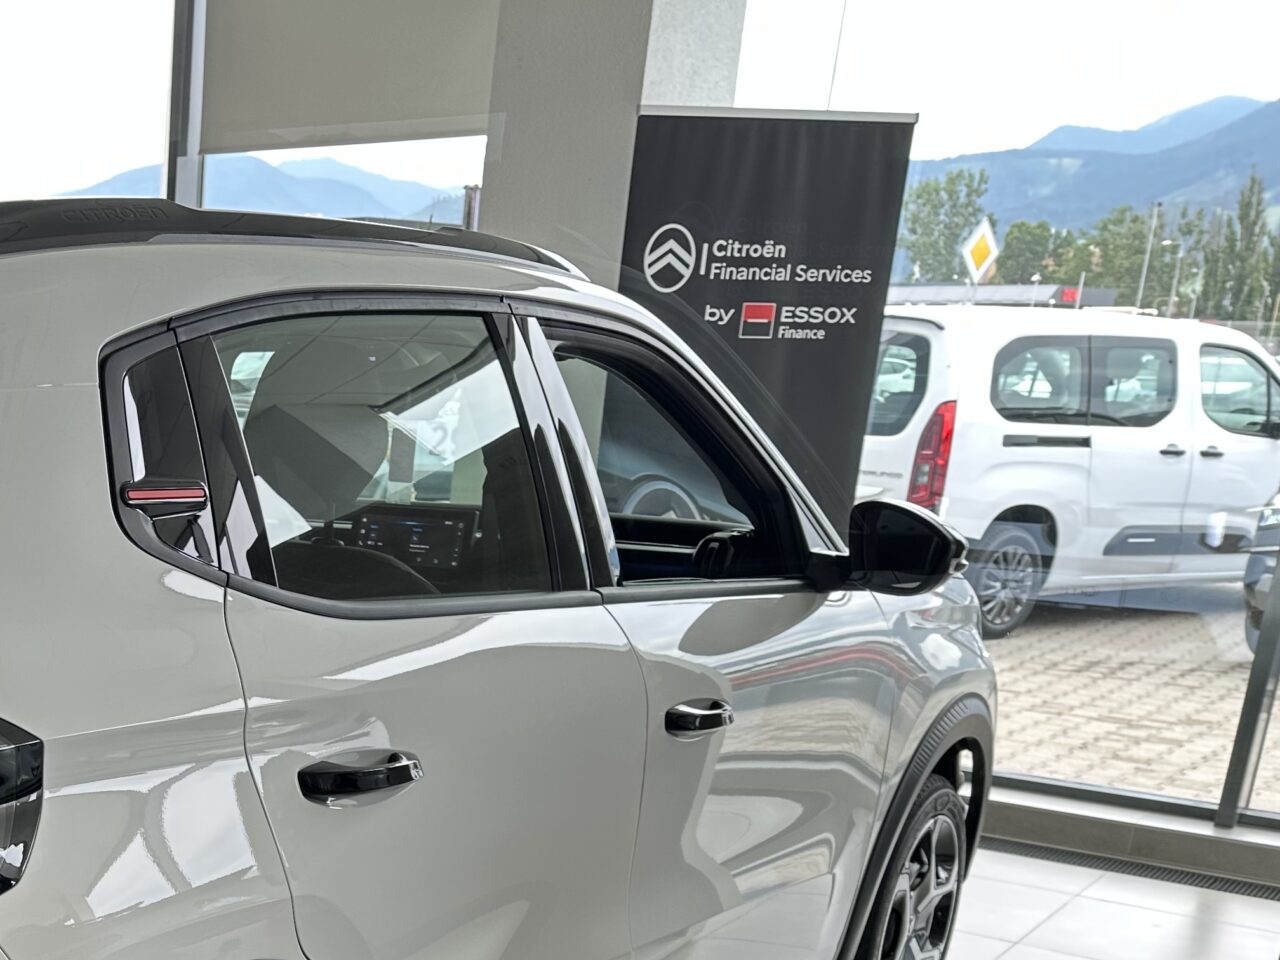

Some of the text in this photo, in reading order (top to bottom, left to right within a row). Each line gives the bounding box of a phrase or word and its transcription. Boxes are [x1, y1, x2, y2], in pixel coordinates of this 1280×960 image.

[712, 239, 786, 258] Citroën
[710, 263, 872, 283] Financial Services
[704, 305, 858, 325] by ESSOX
[778, 326, 825, 340] Finance
